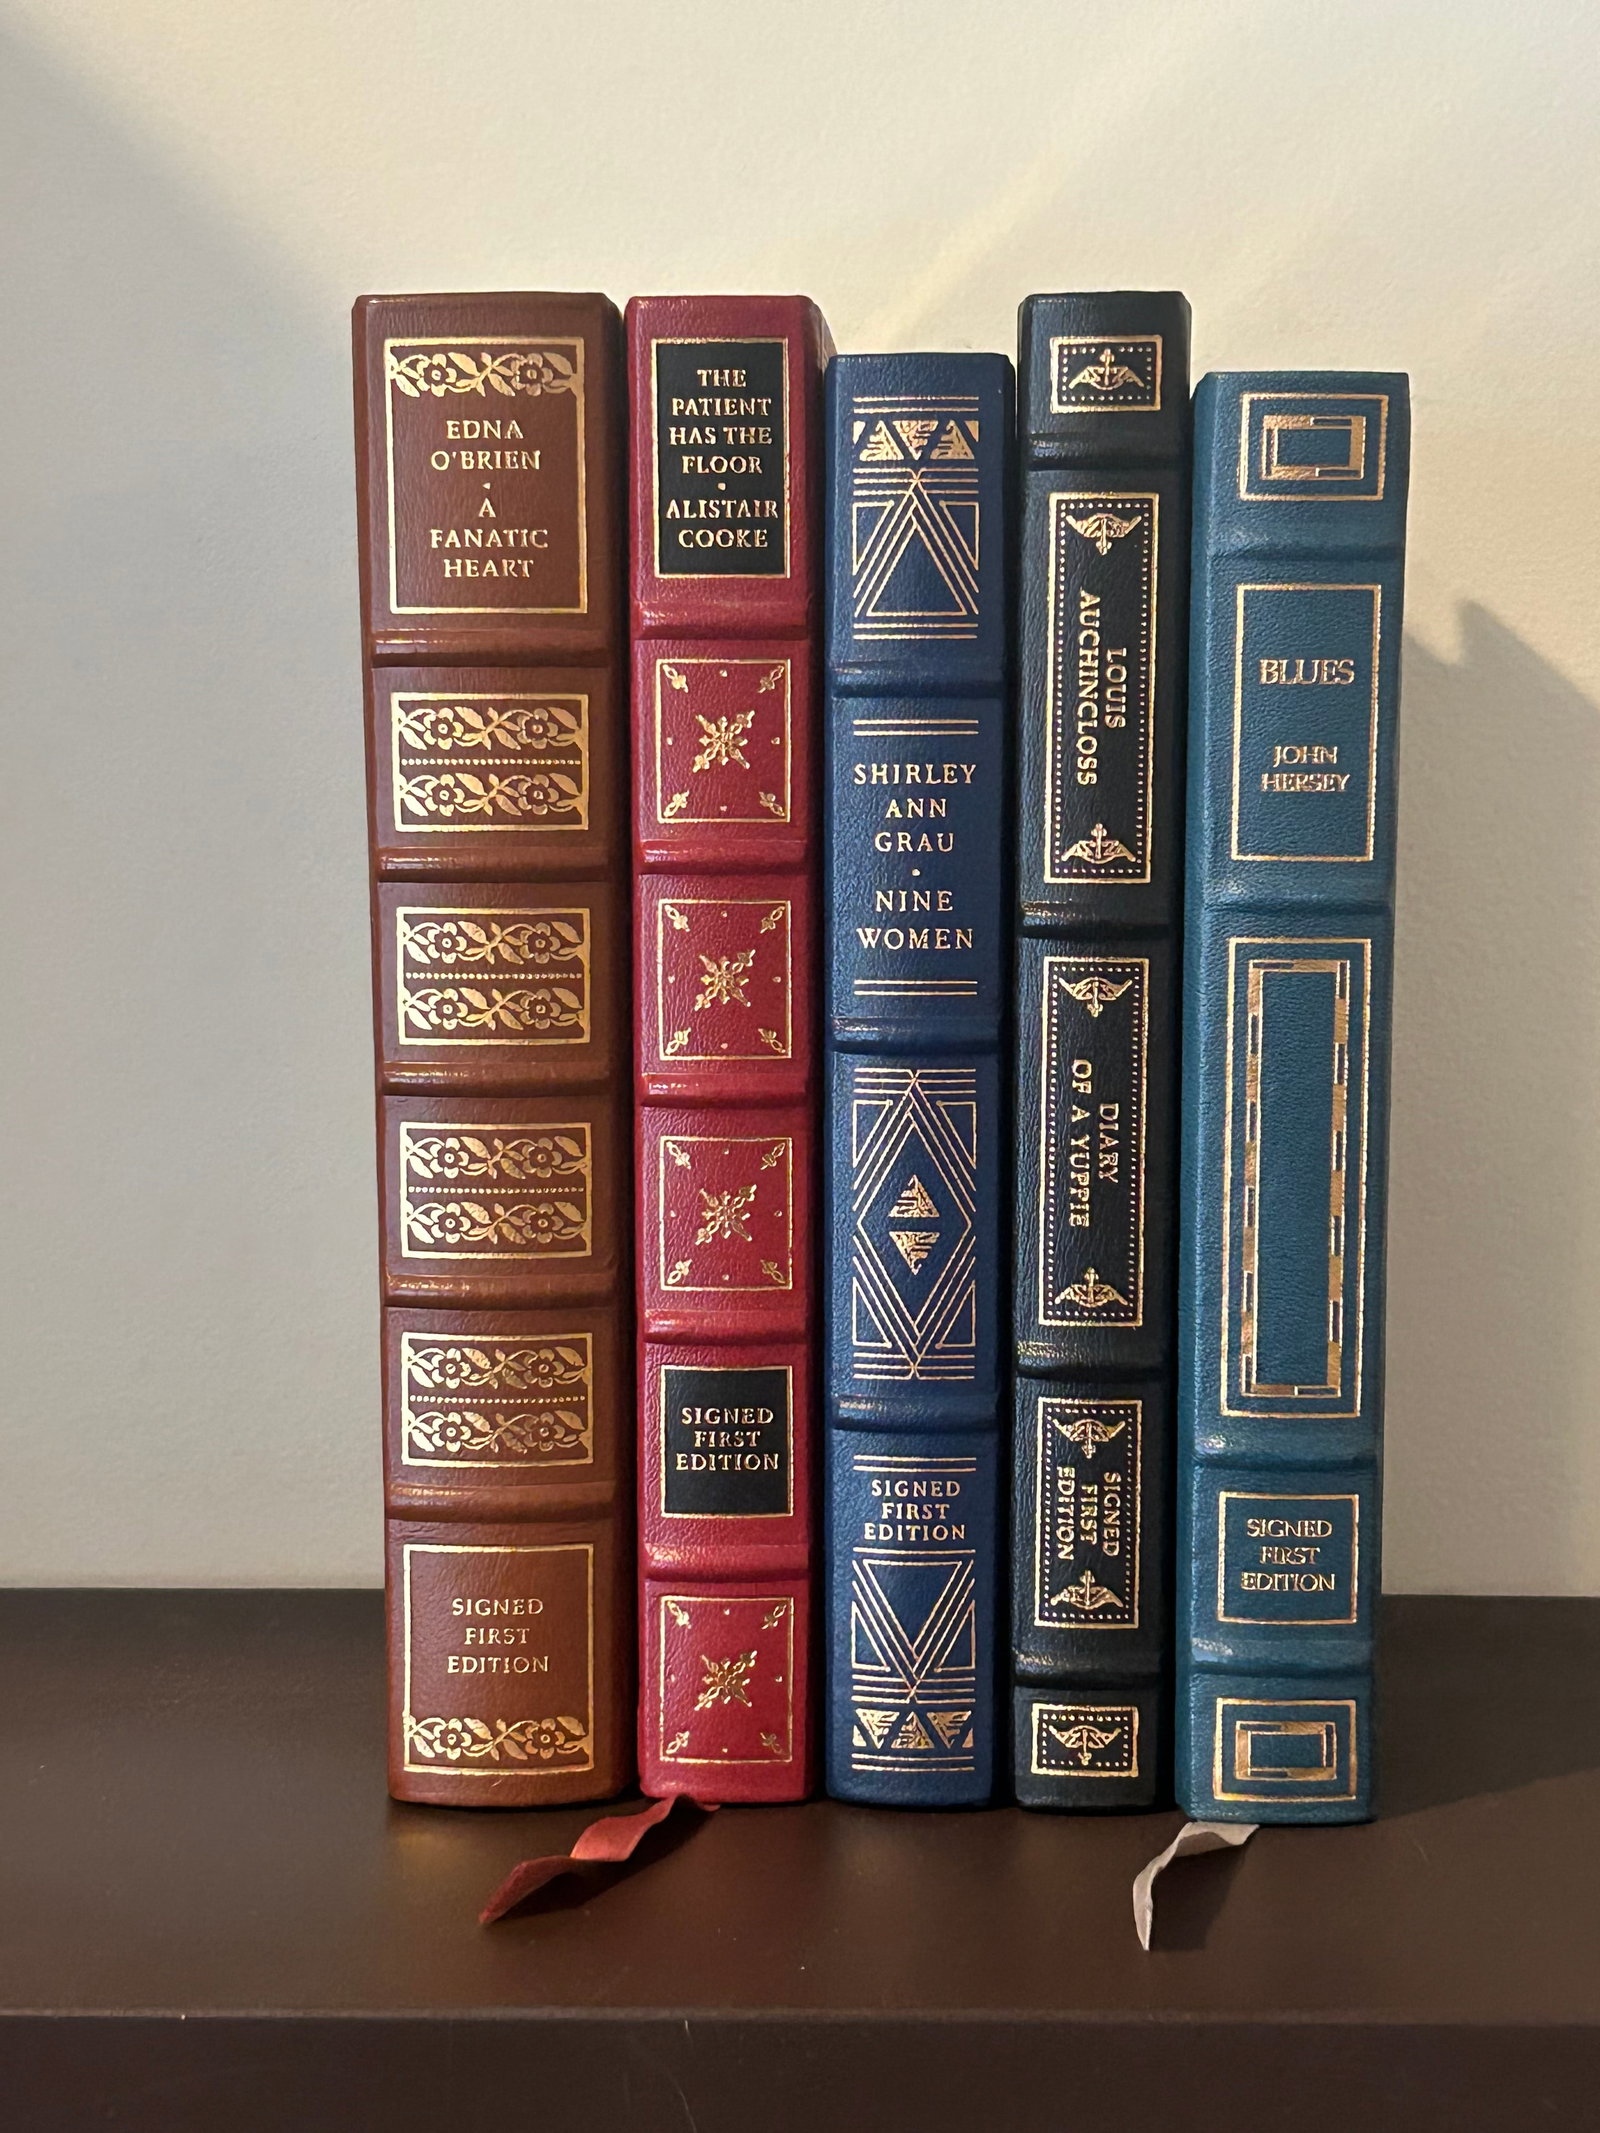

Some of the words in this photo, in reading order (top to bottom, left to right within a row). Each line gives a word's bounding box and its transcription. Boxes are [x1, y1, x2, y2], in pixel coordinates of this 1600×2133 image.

[697, 369, 747, 388] THE
[671, 398, 771, 417] PATIENT
[446, 420, 524, 440] EDNA
[669, 427, 717, 446] HAS
[722, 427, 772, 446] THE
[430, 450, 540, 471] O'BRIEN
[681, 456, 763, 475] FLOOR
[478, 497, 496, 518] A
[665, 500, 779, 519] ALISTAIR
[430, 529, 548, 549] FANATIC
[678, 529, 769, 549] COOKE
[443, 559, 534, 579] HEART
[1259, 659, 1355, 685] BLUES
[1077, 589, 1101, 786] AUCHINCLOSS
[1105, 647, 1127, 729] LOUIS
[1272, 745, 1338, 768] JOHN
[854, 763, 977, 785] SHIRLEY
[1261, 773, 1351, 793] HERSEY
[885, 798, 947, 819] ANN
[874, 832, 954, 852] GRAU
[875, 890, 953, 912] NINE
[857, 928, 974, 950] WOMEN
[1071, 1059, 1092, 1094] OF
[1071, 1104, 1091, 1123] A
[1098, 1103, 1119, 1183] DIARY
[1068, 1133, 1090, 1228] YUPPIE
[681, 1407, 774, 1425] SIGNED
[694, 1430, 761, 1447] FIRST
[675, 1453, 780, 1471] EDITION
[871, 1480, 961, 1497] SIGNED
[881, 1503, 950, 1520] FIRST
[1056, 1466, 1076, 1561] EDITION
[1080, 1484, 1098, 1546] FIRST
[1103, 1471, 1122, 1557] SIGNED
[864, 1522, 966, 1541] EDITION
[1246, 1518, 1333, 1539] SIGNED
[1259, 1546, 1321, 1565] FIRST
[1240, 1572, 1335, 1592] EDITION
[452, 1598, 544, 1616] SIGNED
[464, 1627, 530, 1645] FIRST
[447, 1655, 549, 1674] EDITION
